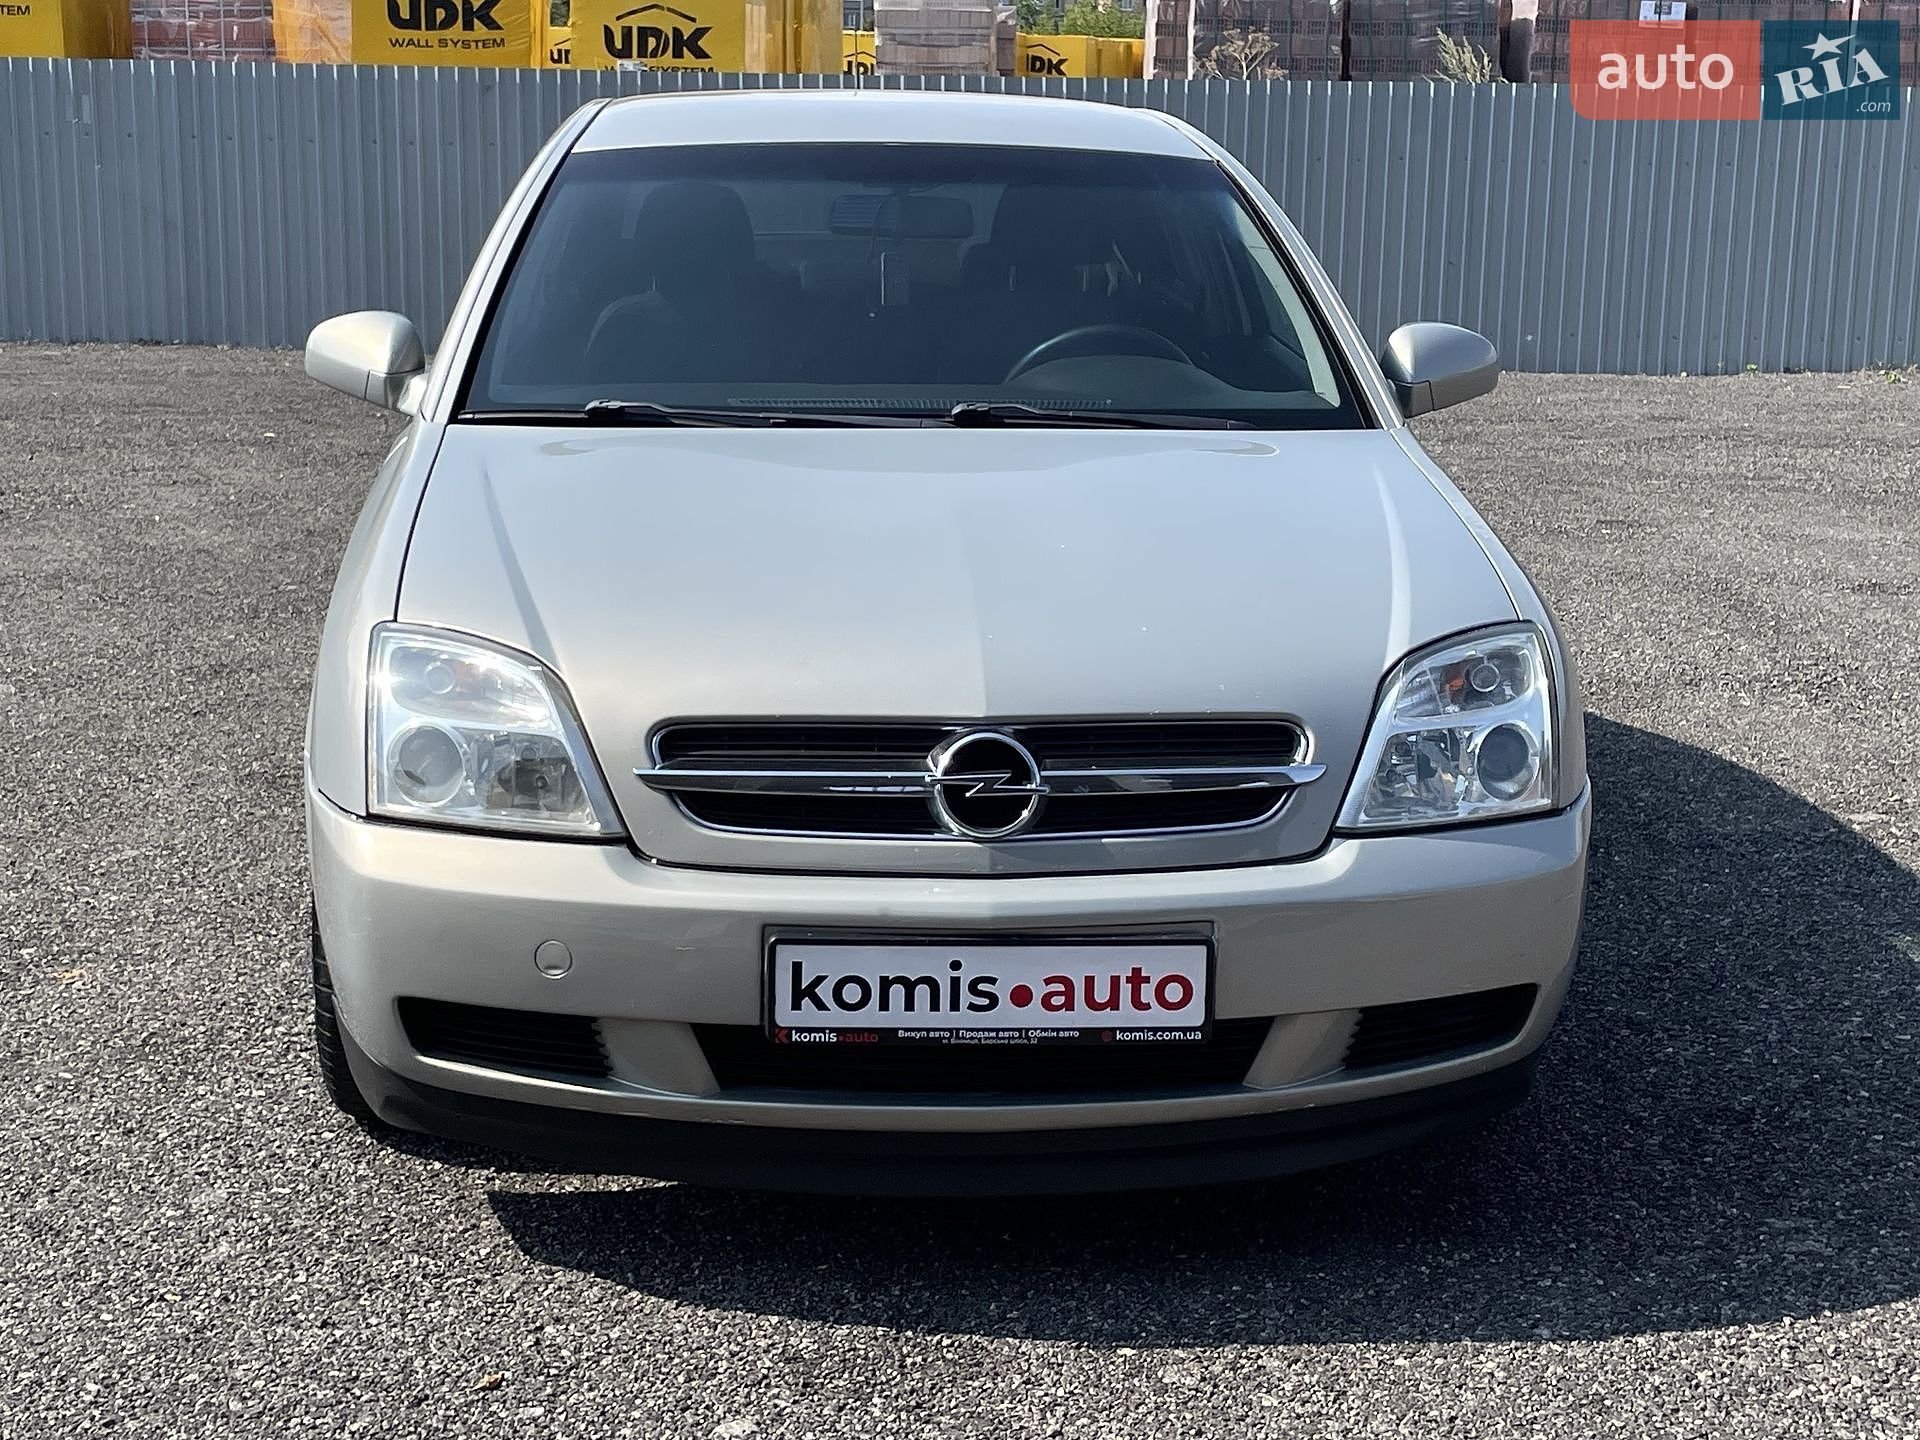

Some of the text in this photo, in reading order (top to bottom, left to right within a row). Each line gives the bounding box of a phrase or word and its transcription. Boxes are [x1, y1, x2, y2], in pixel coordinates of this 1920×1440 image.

[386, 0, 505, 31] UDK
[389, 38, 506, 49] WALL SYSTEM
[603, 24, 713, 60] UDK
[898, 1030, 927, 1040] Викуп
[959, 1030, 996, 1039] Продаж
[1028, 1029, 1057, 1038] Обмін
[1116, 1029, 1202, 1041] komis.com.ua
